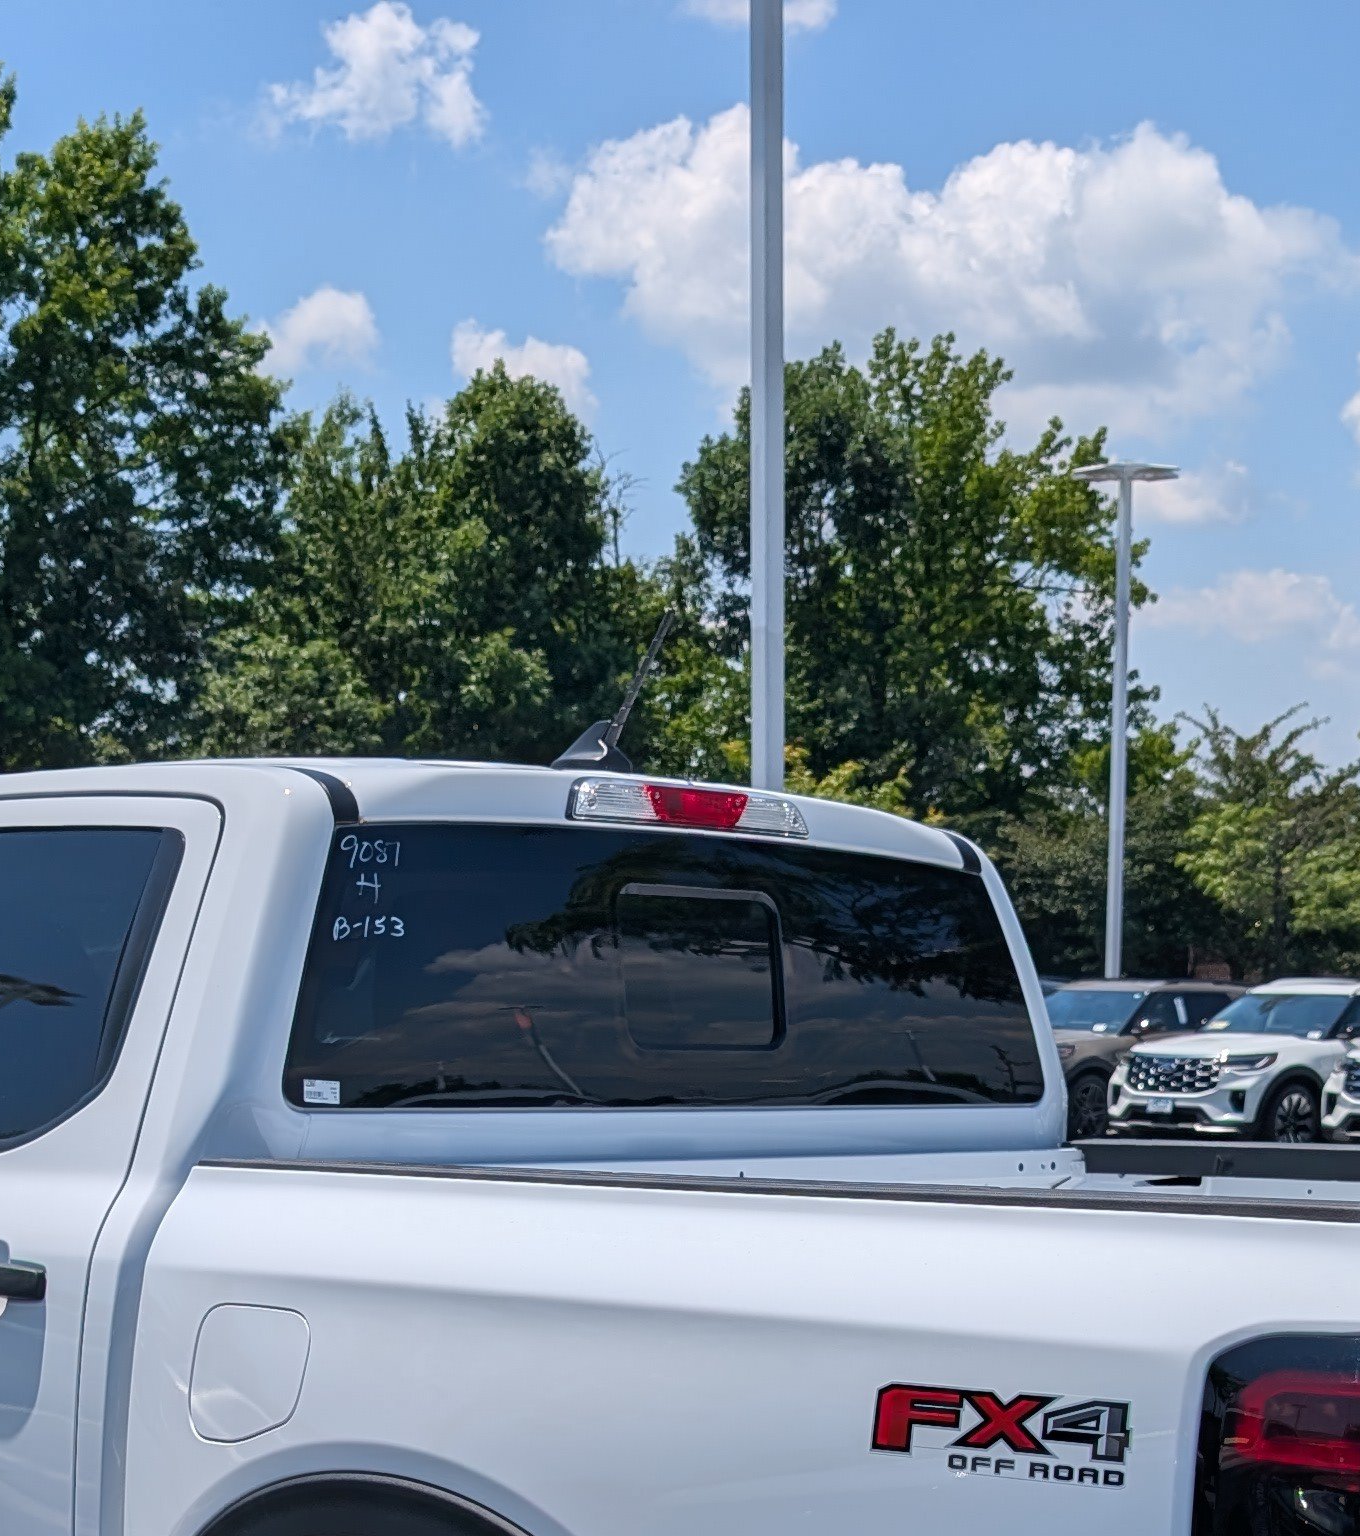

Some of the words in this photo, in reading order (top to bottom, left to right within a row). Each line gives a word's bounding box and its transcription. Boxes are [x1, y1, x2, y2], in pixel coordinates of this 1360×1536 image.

[333, 915, 405, 941] B-153
[871, 1382, 1133, 1464] FX4
[947, 1453, 1016, 1475] OFF
[1028, 1461, 1125, 1486] ROAD
